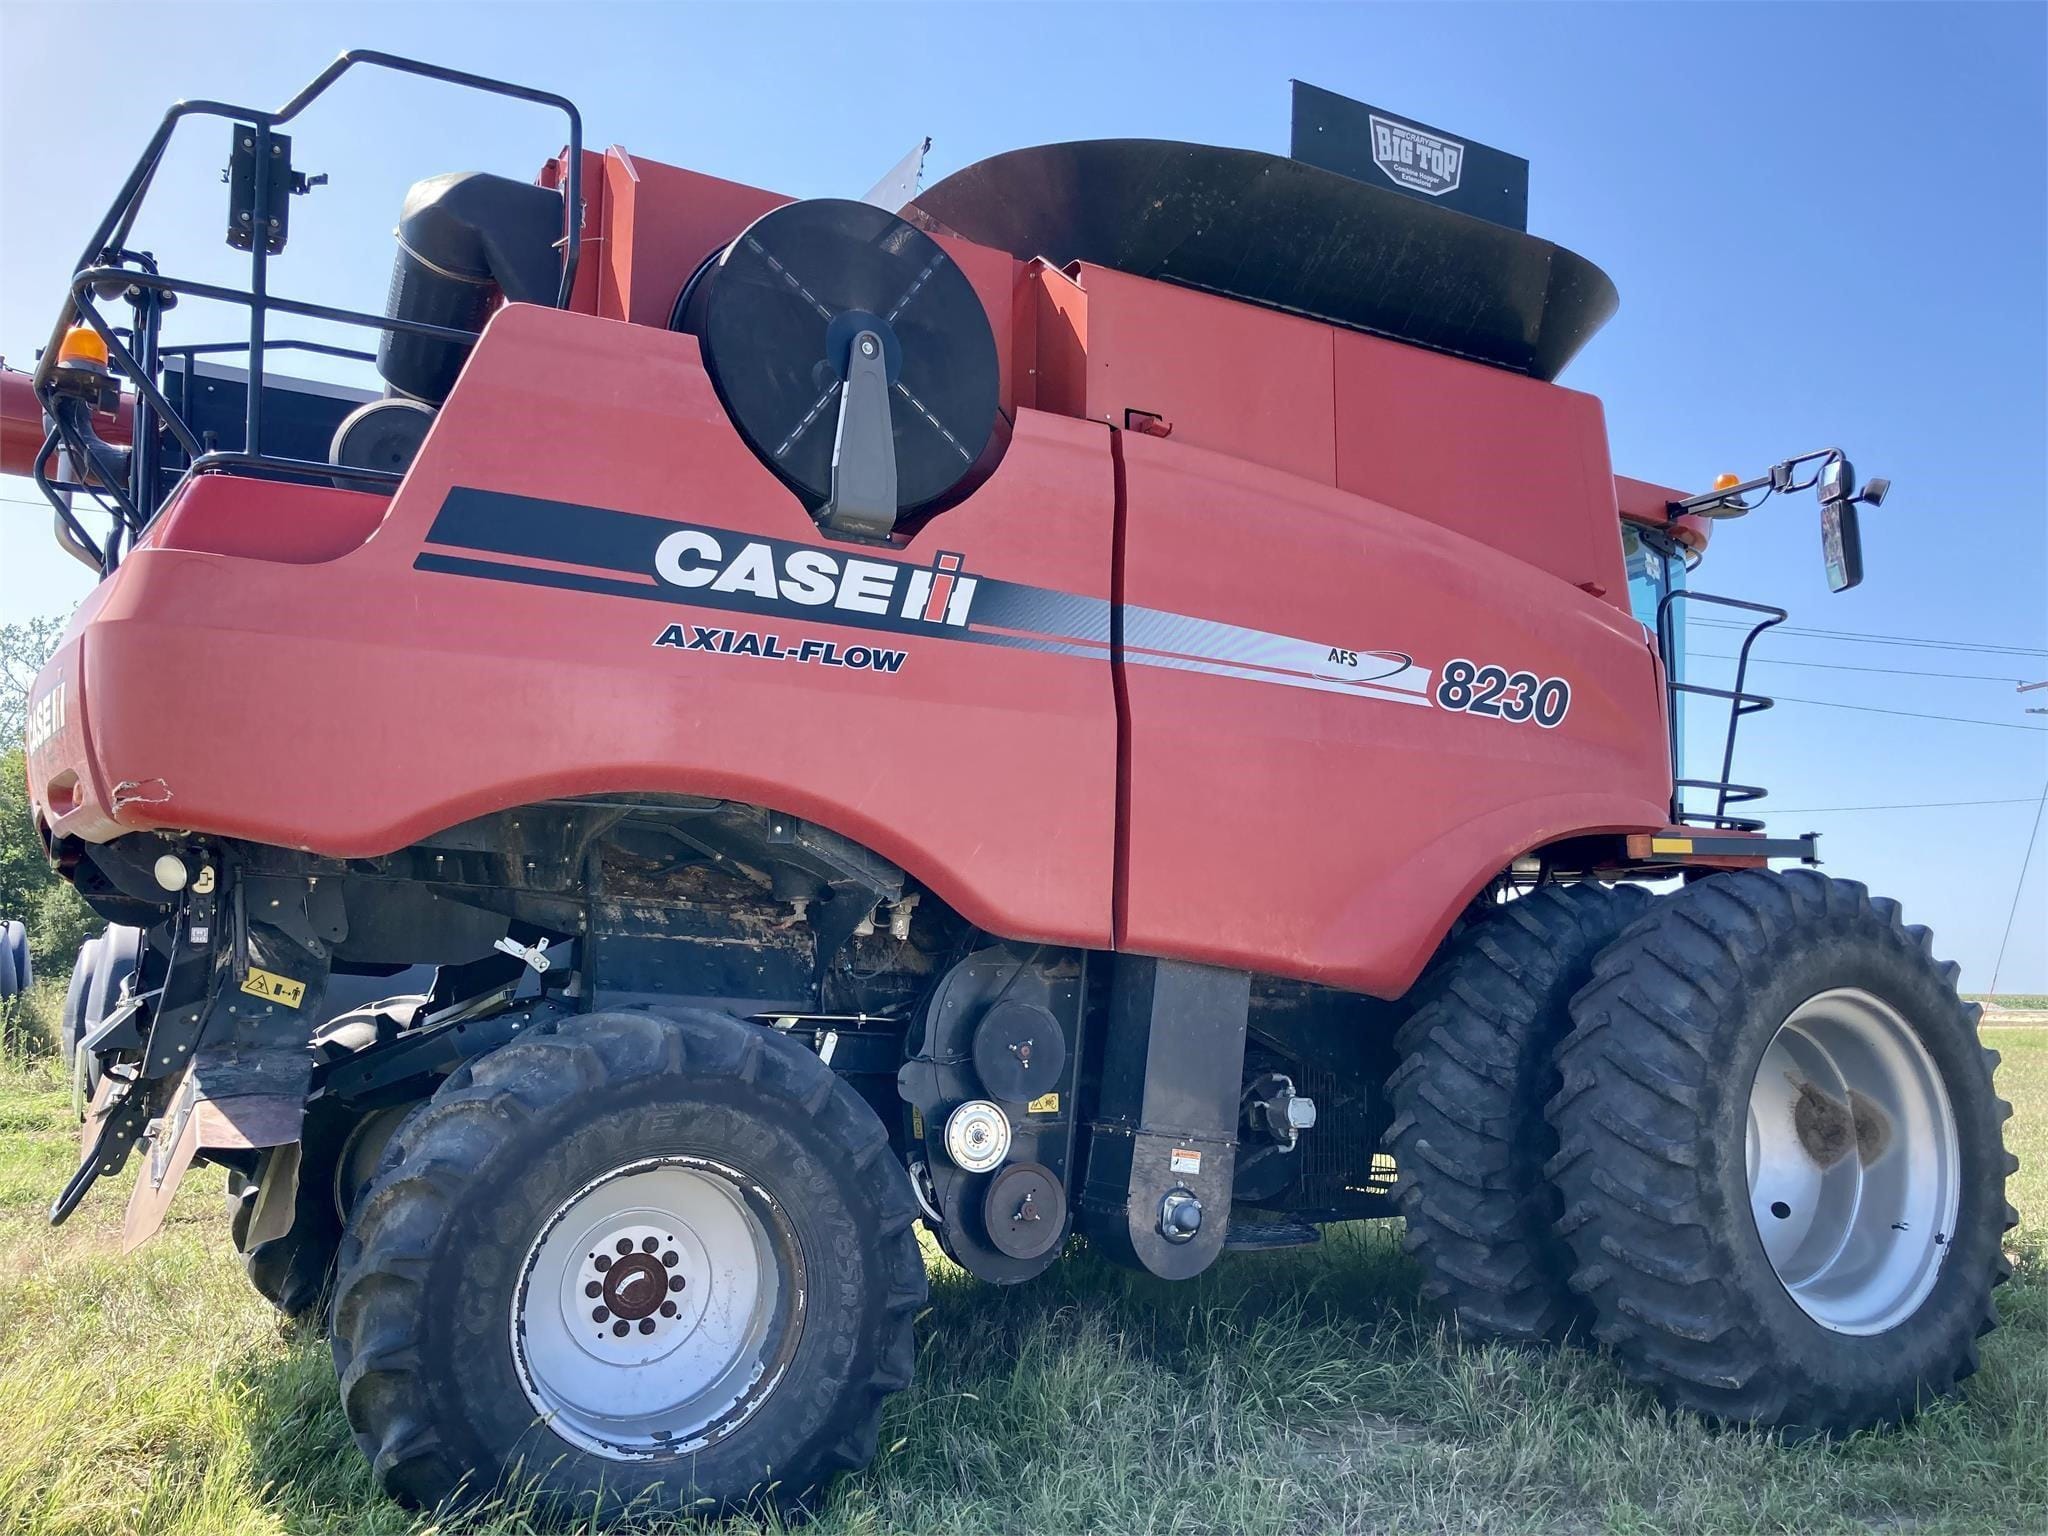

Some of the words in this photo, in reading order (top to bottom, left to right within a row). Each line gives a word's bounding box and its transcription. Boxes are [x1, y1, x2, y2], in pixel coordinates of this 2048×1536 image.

[1375, 125, 1413, 165] BIG
[1416, 142, 1458, 182] TOP
[1393, 163, 1418, 178] Combine
[655, 530, 898, 615] CASE
[653, 623, 908, 674] AXIAL-FLOW
[1327, 647, 1358, 667] AFS
[1435, 658, 1572, 729] 8230
[28, 693, 51, 757] ASE
